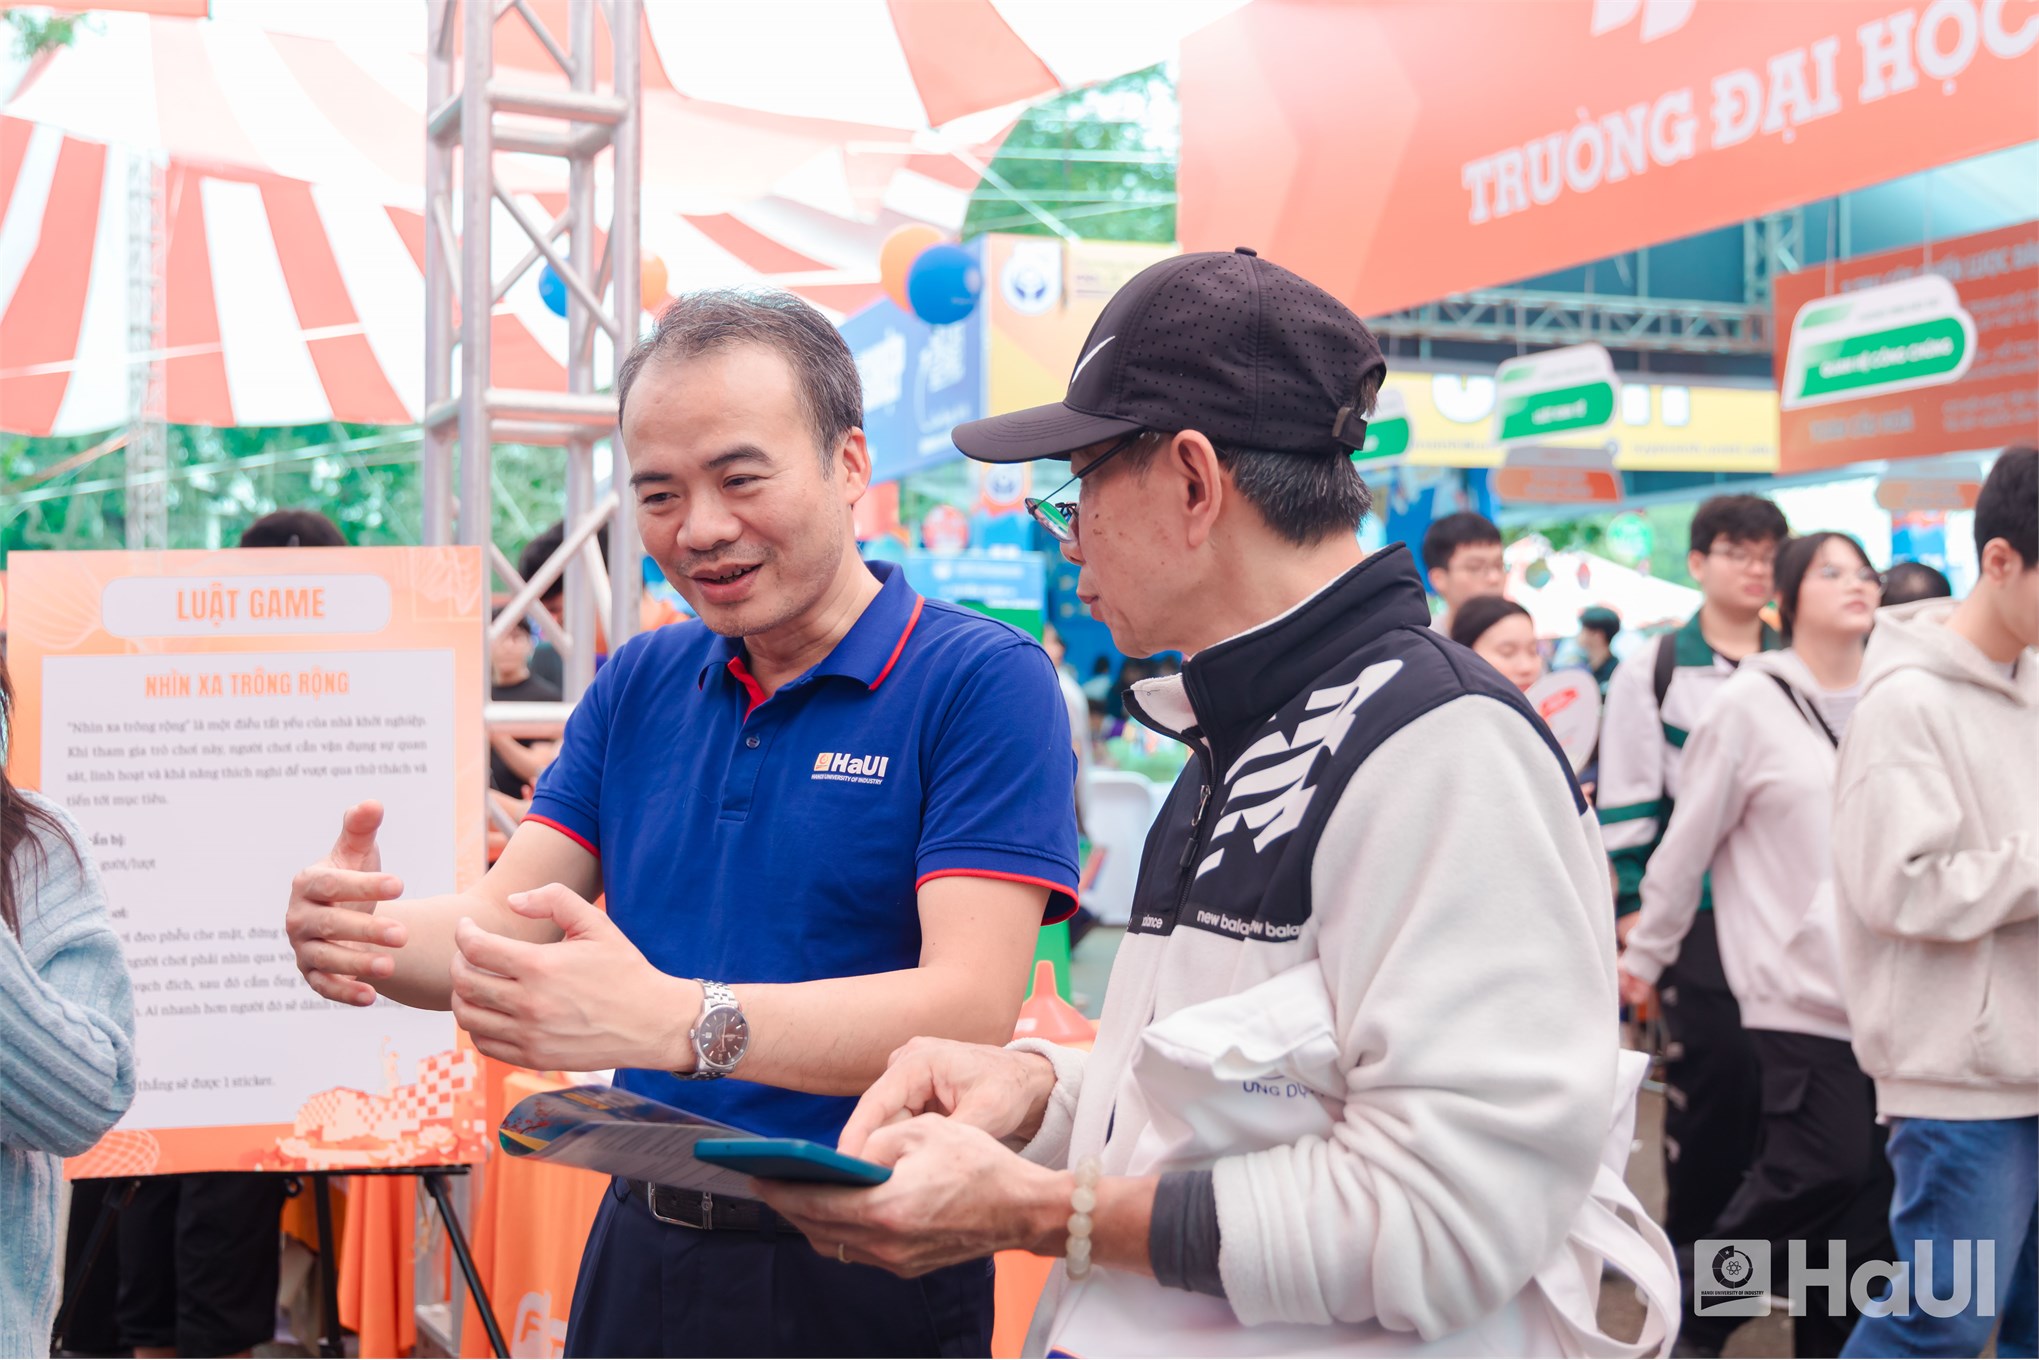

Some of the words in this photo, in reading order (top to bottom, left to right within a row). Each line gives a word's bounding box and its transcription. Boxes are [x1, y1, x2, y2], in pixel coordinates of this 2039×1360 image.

[1711, 35, 1842, 145] ĐẠI
[1858, 0, 2039, 105] HỌC
[177, 581, 240, 628] LUẬT
[249, 587, 326, 620] GAME
[145, 668, 190, 698] NHÌN
[198, 673, 223, 698] XA
[230, 665, 292, 697] TRÔNG
[298, 664, 350, 702] RỘNG
[107, 723, 120, 733] xa
[67, 746, 88, 758] Khi
[92, 747, 124, 758] tham
[129, 746, 146, 758] gia
[398, 740, 427, 751] quan
[831, 753, 889, 777] HaUI
[825, 774, 851, 782] UNIVERSITY
[858, 777, 883, 785] INDUSTRY
[1197, 910, 1221, 926] new
